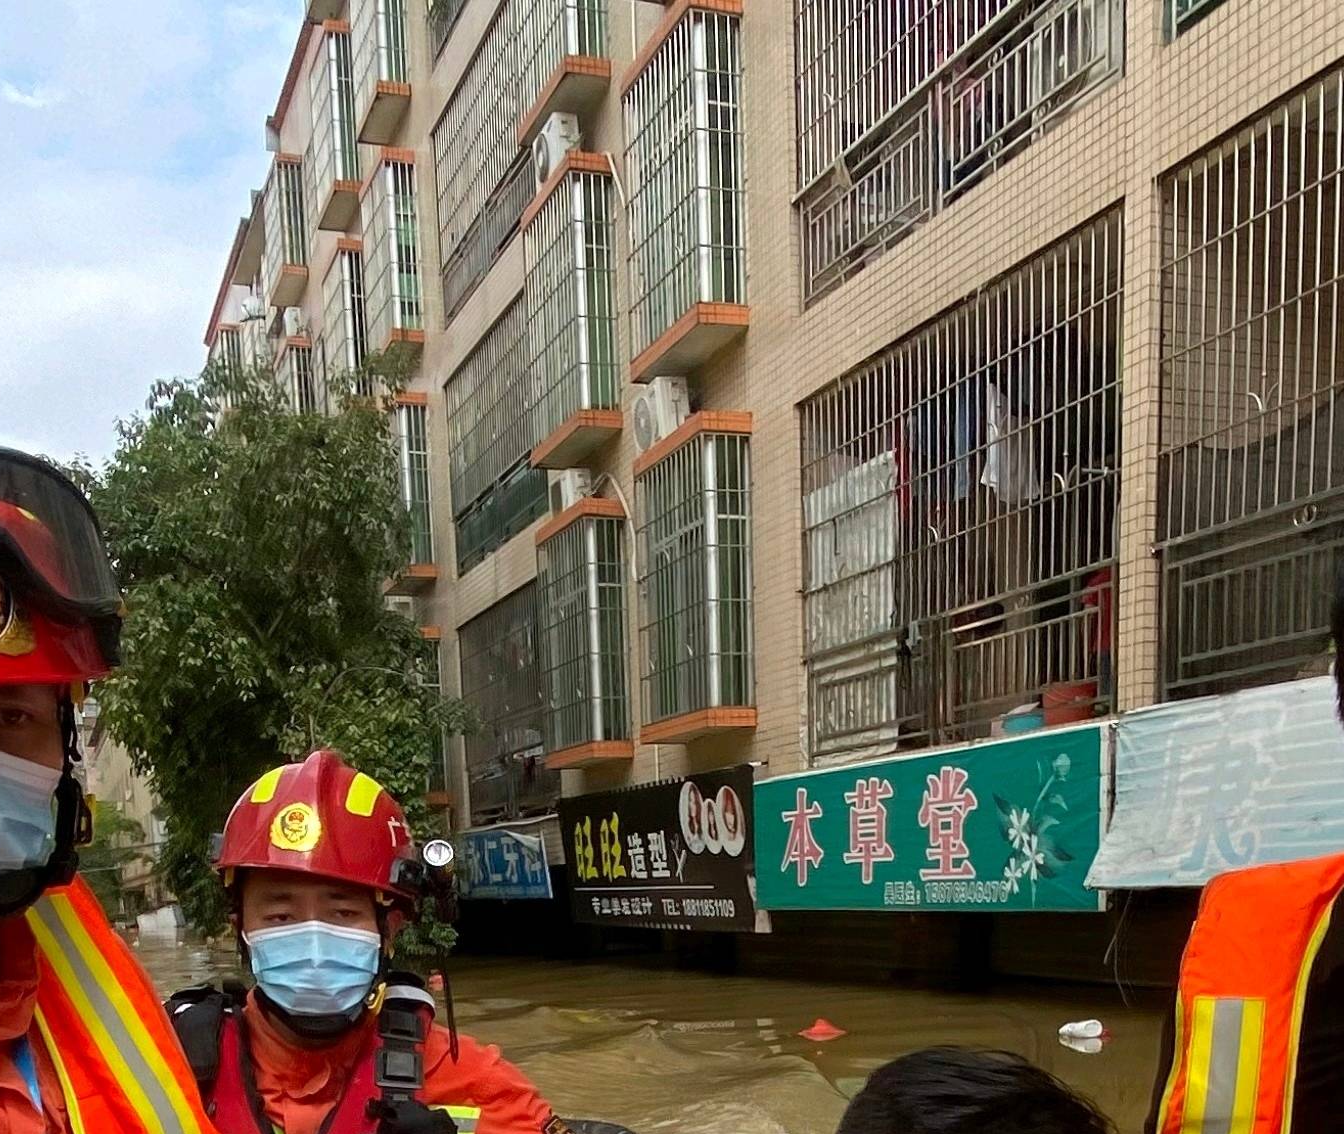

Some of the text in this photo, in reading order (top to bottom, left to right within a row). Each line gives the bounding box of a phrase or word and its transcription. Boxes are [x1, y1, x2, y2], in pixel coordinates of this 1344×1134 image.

[573, 811, 672, 883] 旺旺造型
[779, 765, 979, 888] 本草堂
